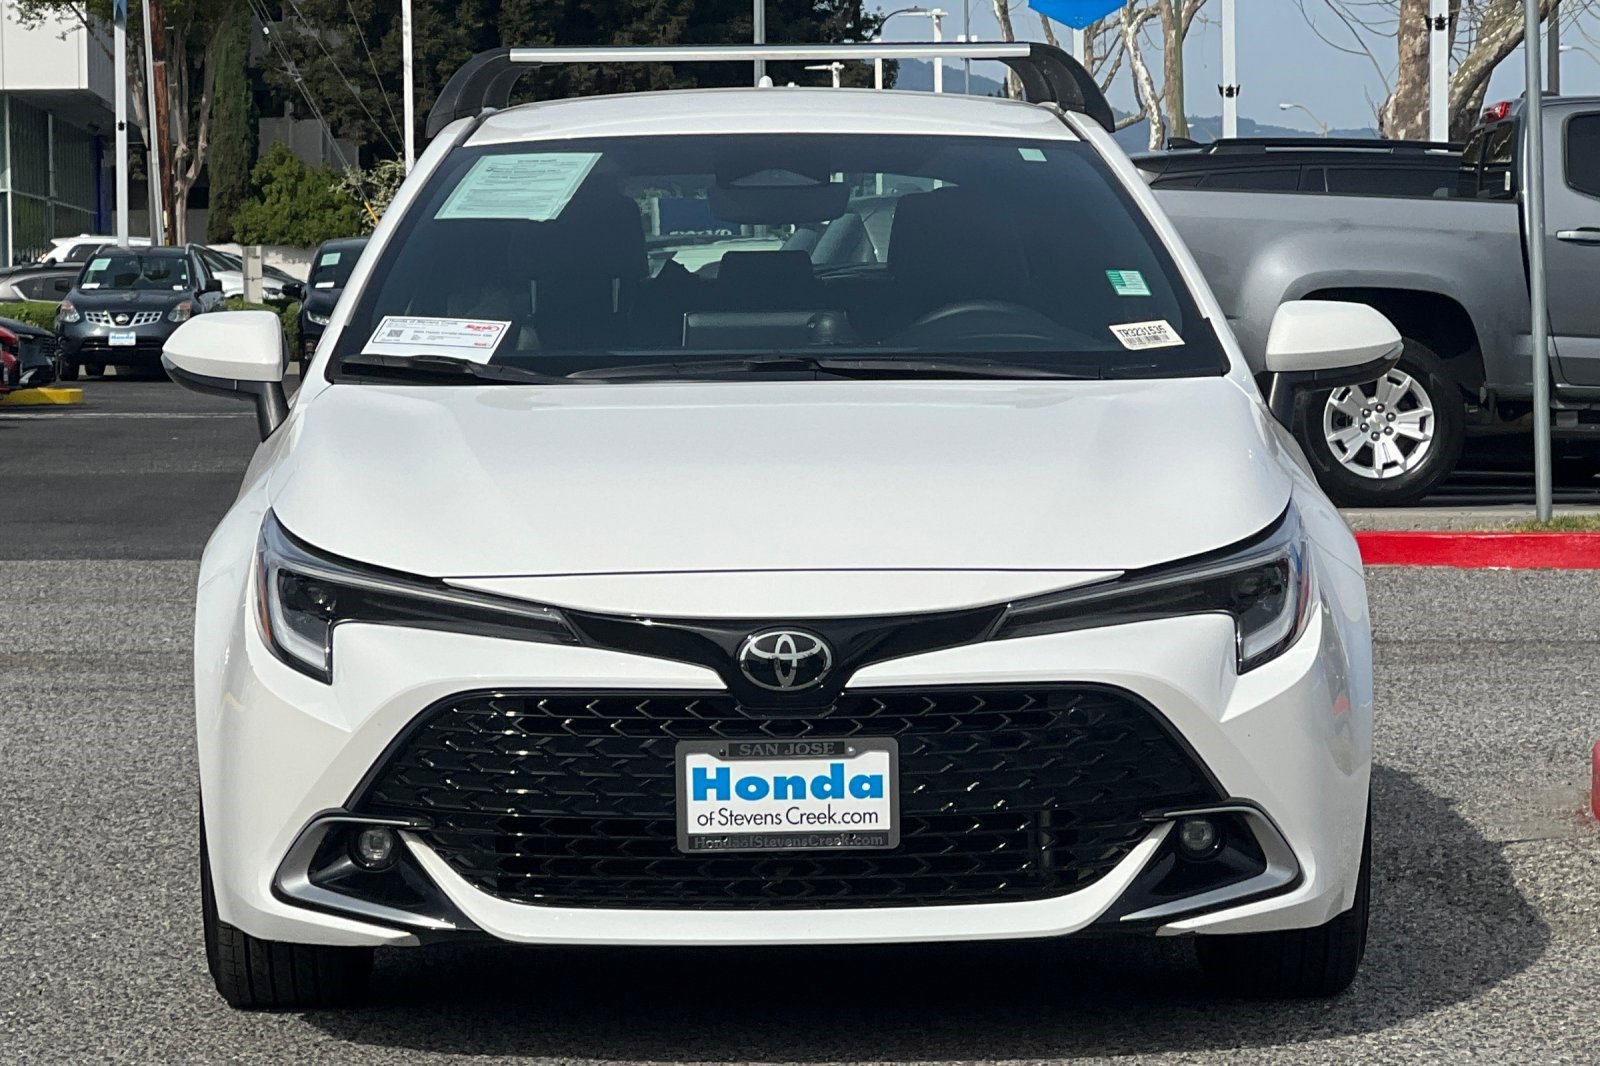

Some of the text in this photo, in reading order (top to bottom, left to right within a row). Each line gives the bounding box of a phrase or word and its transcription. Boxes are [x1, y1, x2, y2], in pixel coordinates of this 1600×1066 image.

[739, 742, 834, 755] SAN JOSE
[692, 763, 883, 801] Honda
[697, 803, 878, 826] of Stevens Creek.com
